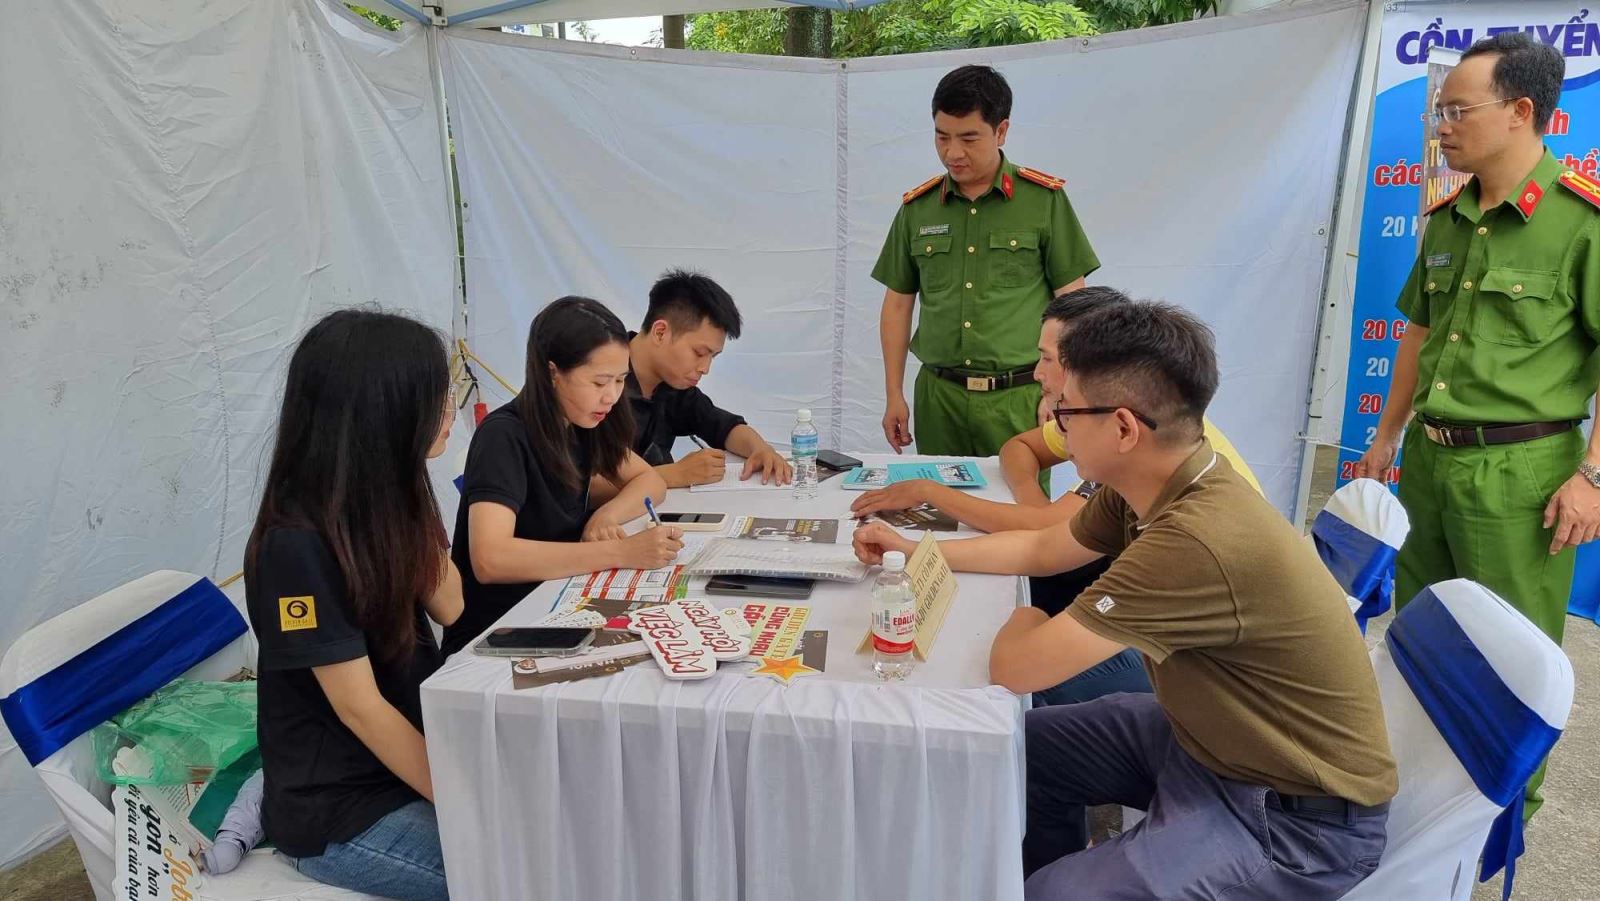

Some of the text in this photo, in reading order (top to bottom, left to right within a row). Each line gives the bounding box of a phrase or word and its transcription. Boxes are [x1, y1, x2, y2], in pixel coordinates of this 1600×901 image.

[1382, 216, 1406, 237] 20
[1362, 319, 1387, 341] 20
[1365, 357, 1390, 378] 20
[1358, 394, 1383, 414] 20
[678, 600, 741, 653] NGÀY HỘI
[635, 602, 708, 674] VIỆC LÀM
